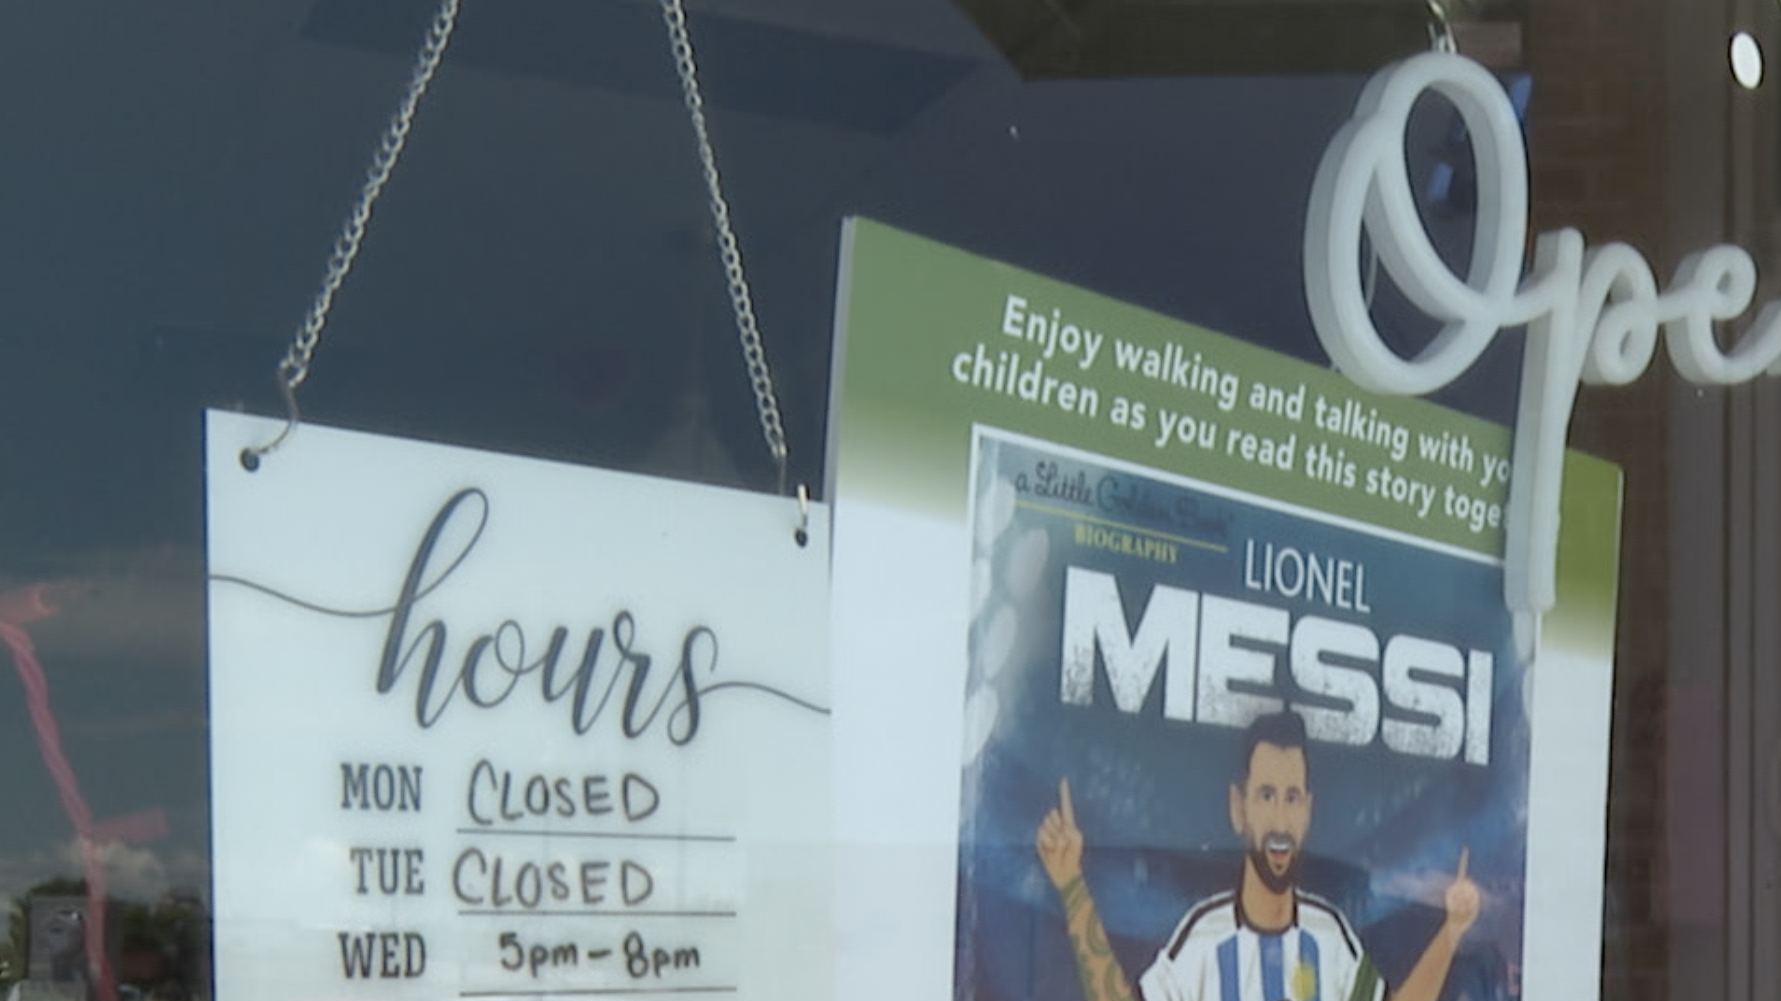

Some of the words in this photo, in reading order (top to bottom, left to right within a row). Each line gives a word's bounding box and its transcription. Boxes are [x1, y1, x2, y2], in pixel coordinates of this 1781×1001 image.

[1003, 294, 1103, 371] Enjoy
[1115, 337, 1240, 412] walking
[1249, 381, 1306, 421] and
[1314, 396, 1410, 462] talking
[1418, 431, 1474, 472] with
[1479, 457, 1513, 488] yo
[952, 342, 1099, 418] children
[1109, 396, 1147, 430] as
[1155, 408, 1217, 449] you
[1226, 428, 1297, 471] read
[1305, 443, 1358, 489] this
[1365, 465, 1437, 519] story
[1443, 484, 1501, 534] toge
[1034, 460, 1094, 507] Little
[1073, 523, 1179, 564] BIOGRAPHY
[1245, 538, 1371, 614] LIONEL
[368, 486, 740, 746] hours
[1060, 565, 1494, 767] MESSI
[340, 763, 423, 813] MON
[467, 759, 660, 825] CLOSED
[350, 847, 425, 896] TUE
[453, 847, 653, 908] CLOSED
[338, 933, 427, 979] WED
